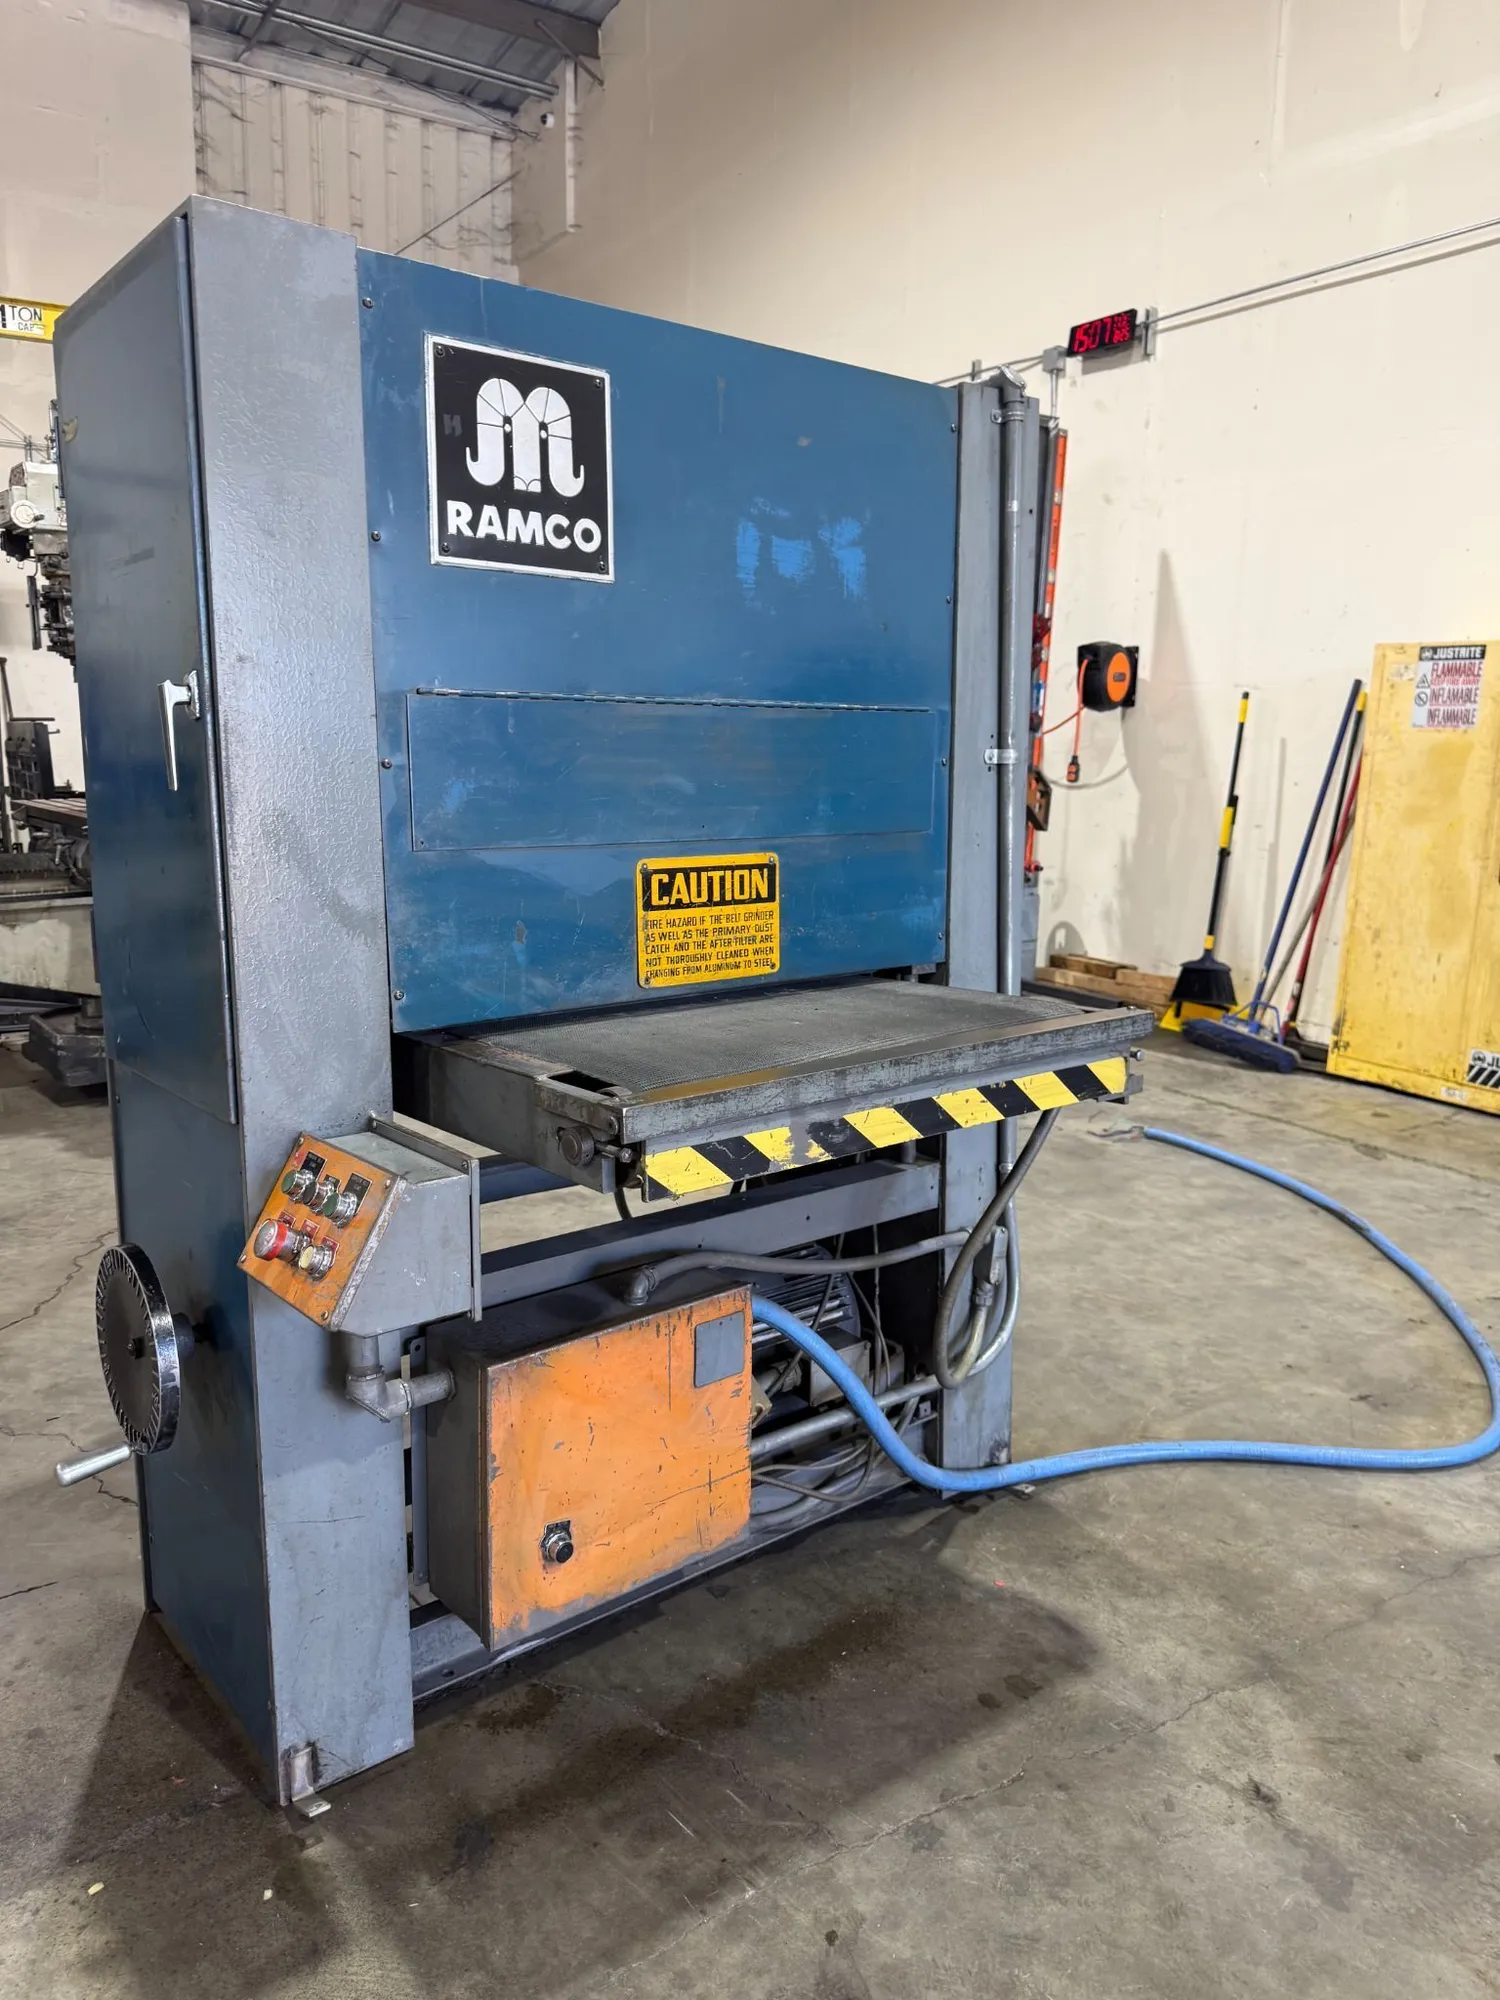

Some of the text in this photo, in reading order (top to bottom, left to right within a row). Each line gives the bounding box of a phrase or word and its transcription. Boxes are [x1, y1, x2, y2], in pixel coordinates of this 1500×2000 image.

[9, 305, 42, 321] TON
[447, 500, 601, 553] RAMCO
[1433, 647, 1482, 659] JUSTRITE
[1431, 662, 1482, 677] FLAMMABLE
[1430, 687, 1479, 703] INFLAMABLE
[1428, 708, 1476, 724] INFLAMMABLE
[651, 868, 768, 905] CAUTION
[666, 916, 697, 928] HAZARD
[699, 915, 706, 926] IF
[710, 914, 722, 925] THE
[726, 912, 741, 923] BELT
[744, 910, 774, 921] GRINDER
[646, 922, 773, 943] AS WELL AS THE PRIMARY DUST
[645, 944, 670, 954] CATCH
[674, 941, 690, 952] AND
[693, 940, 707, 950] THE
[760, 934, 773, 944] ARE
[646, 946, 774, 967] NOT THOROUGHLY CLEANED WHEN
[646, 967, 680, 979] CHANGING
[682, 964, 702, 975] FROM
[704, 960, 741, 973] ALUMINUM
[743, 959, 752, 969] TO
